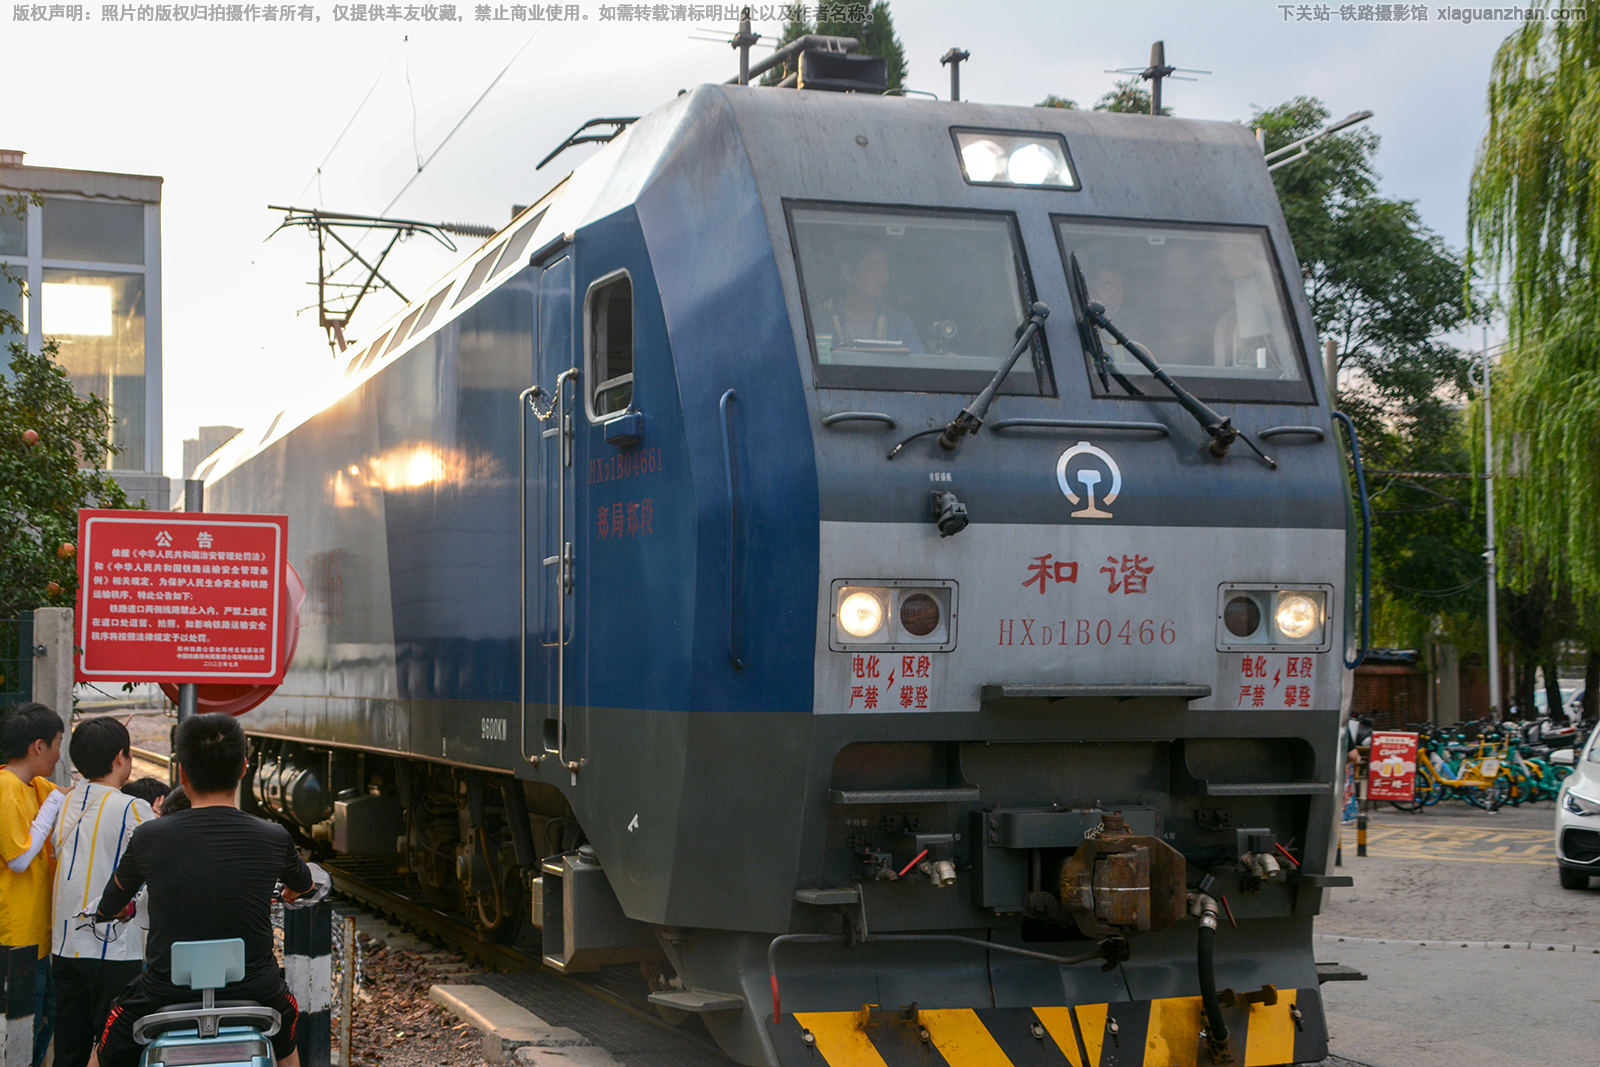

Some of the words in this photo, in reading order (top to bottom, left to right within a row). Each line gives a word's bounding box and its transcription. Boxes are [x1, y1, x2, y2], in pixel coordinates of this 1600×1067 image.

[596, 498, 654, 541] 郑局郑段
[998, 618, 1176, 646] HXD1B0466
[852, 654, 881, 678] 电化
[901, 655, 931, 678] 区段
[1241, 654, 1267, 678] 电化
[1286, 656, 1313, 678] 区段
[848, 684, 879, 709] 严禁
[899, 684, 929, 709] 攀登
[1237, 684, 1266, 708] 严禁
[1283, 684, 1311, 708] 攀登
[481, 717, 507, 741] 9600KW
